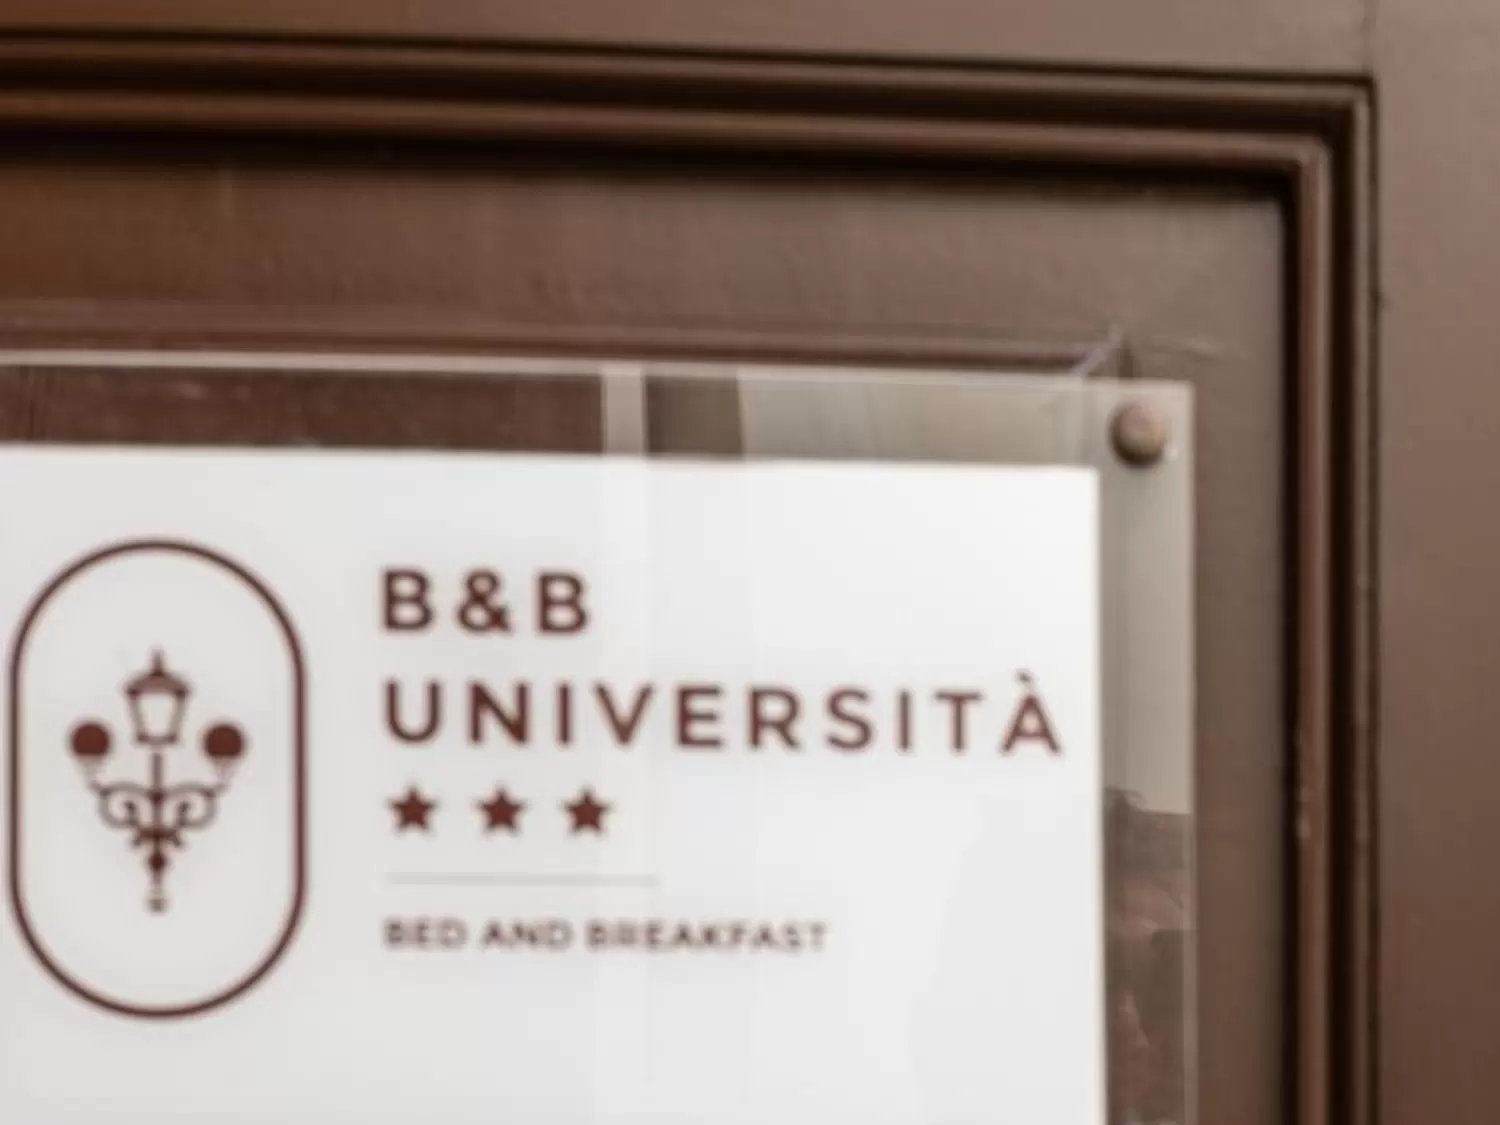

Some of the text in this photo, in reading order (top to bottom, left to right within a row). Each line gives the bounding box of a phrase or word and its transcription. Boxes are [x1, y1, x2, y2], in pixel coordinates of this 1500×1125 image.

[380, 566, 592, 637] B&B
[382, 669, 1062, 755] UNIVERSITÀ
[384, 917, 828, 953] BED AND BREAKFAST
